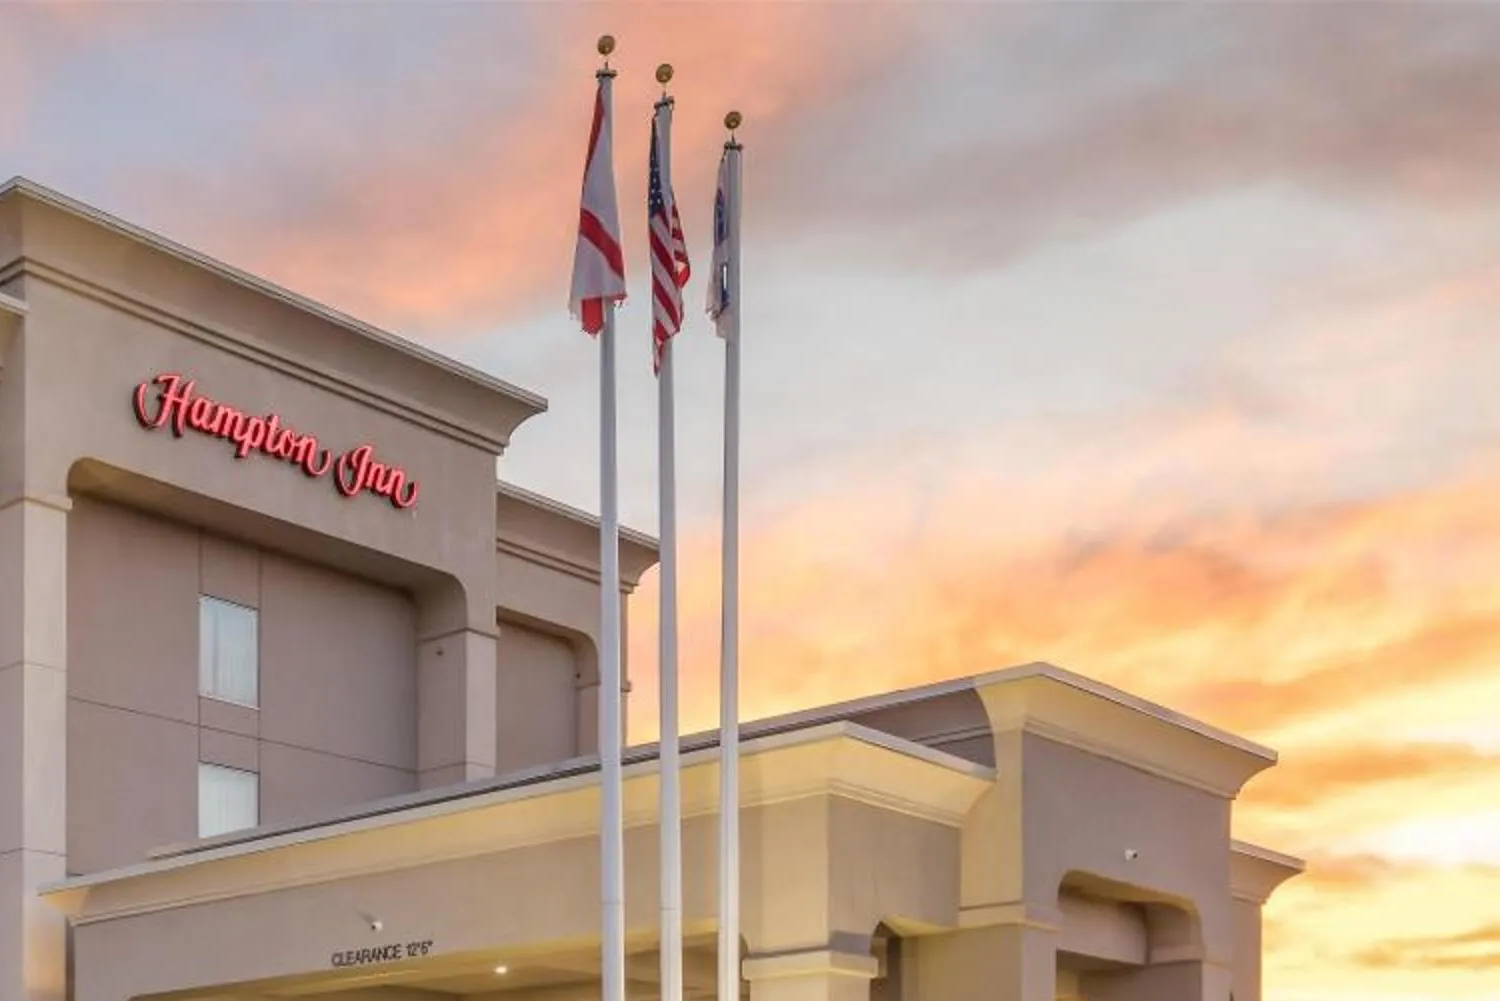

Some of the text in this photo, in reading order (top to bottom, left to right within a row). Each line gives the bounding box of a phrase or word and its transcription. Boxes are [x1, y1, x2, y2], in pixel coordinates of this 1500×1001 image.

[131, 374, 419, 508] Hampton Inn
[331, 944, 402, 967] CLEARANCE
